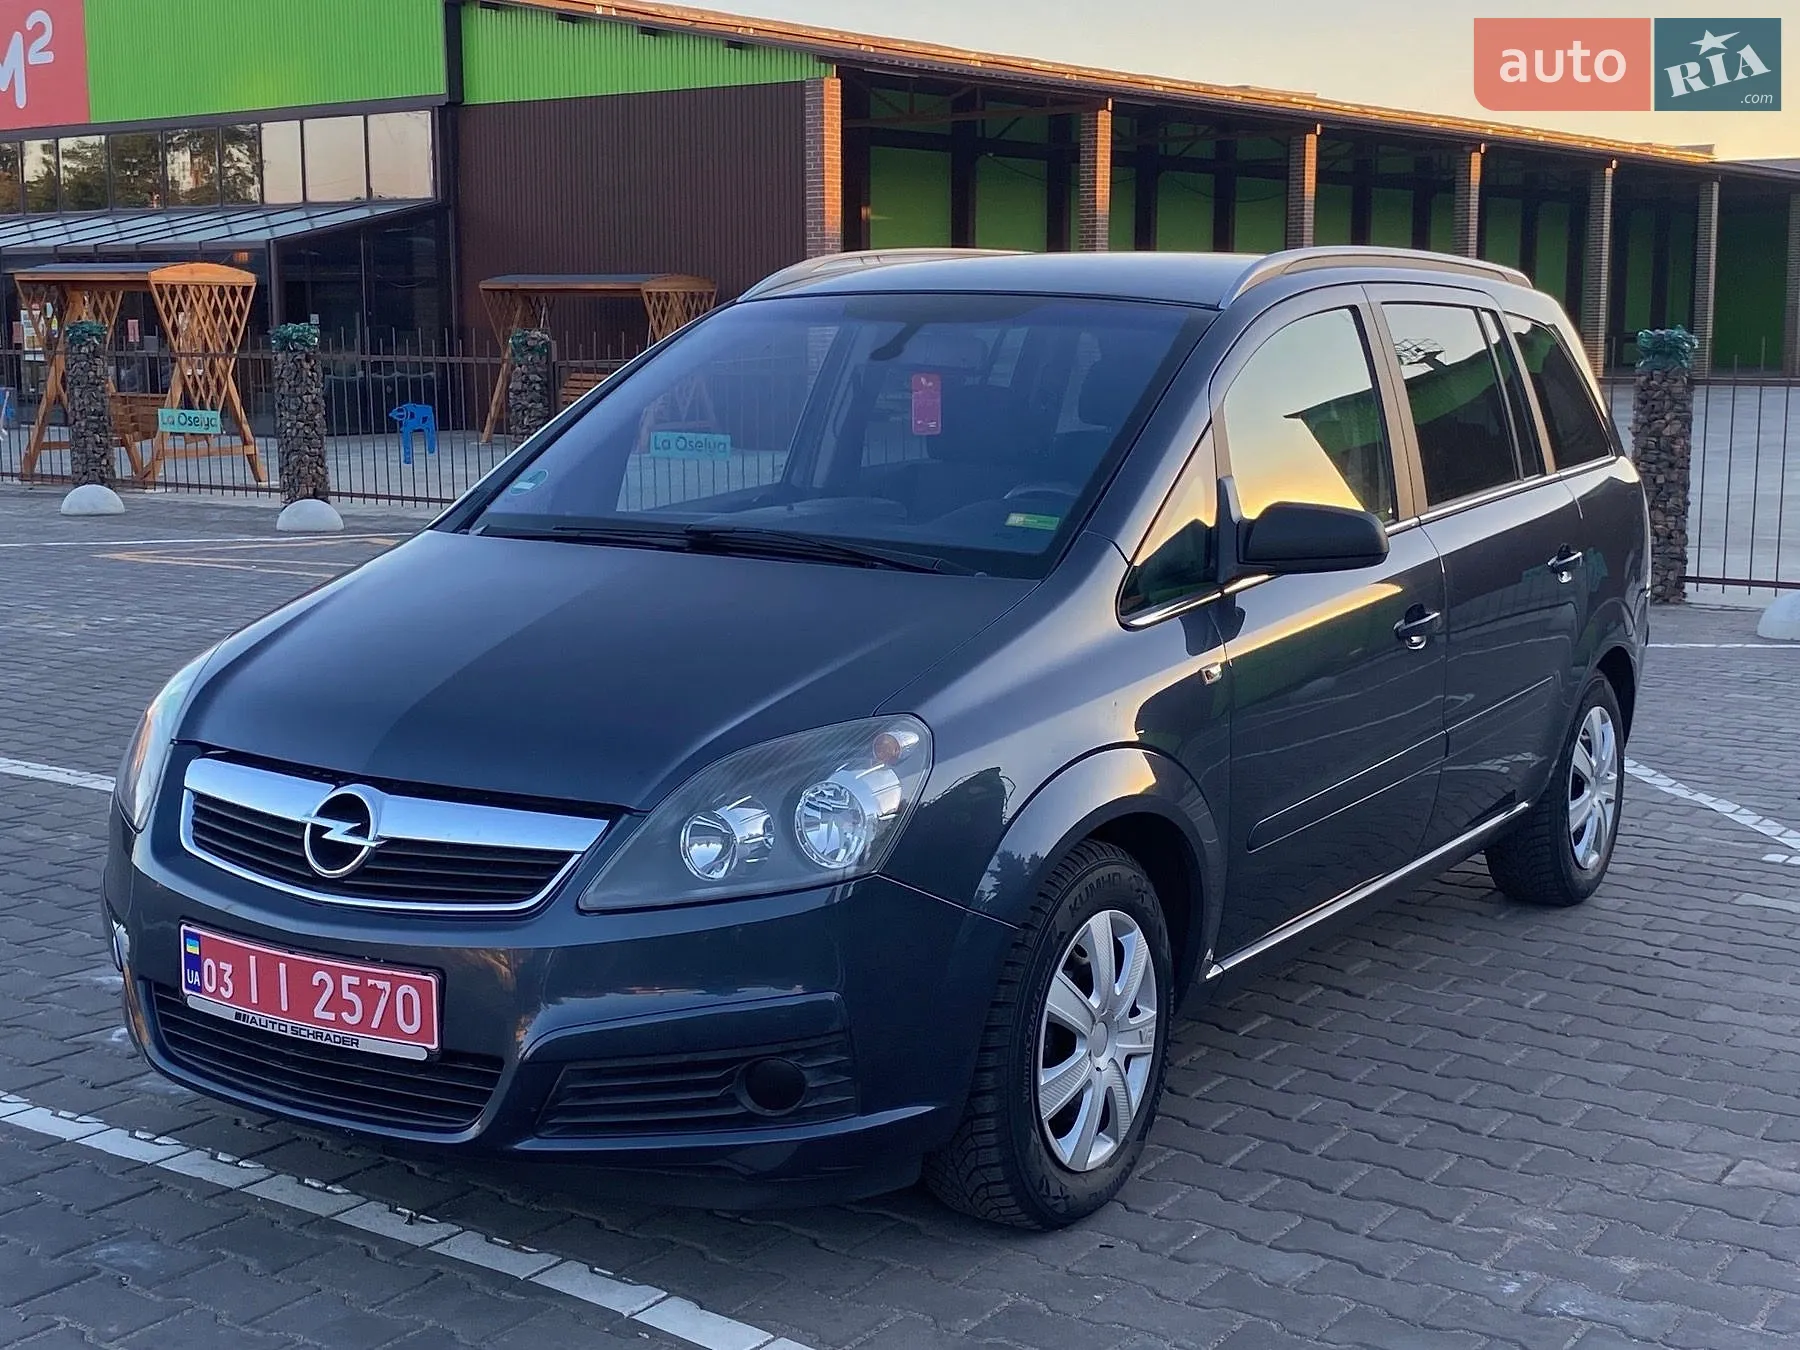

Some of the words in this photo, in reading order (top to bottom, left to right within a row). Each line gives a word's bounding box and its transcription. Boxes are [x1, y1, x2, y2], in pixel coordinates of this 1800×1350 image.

[161, 412, 175, 425] La
[654, 436, 671, 450] La
[187, 968, 200, 987] UA
[203, 958, 233, 999] 03
[312, 970, 421, 1035] 2570
[249, 1016, 288, 1033] AUTO
[290, 1026, 359, 1048] SCHRADER
